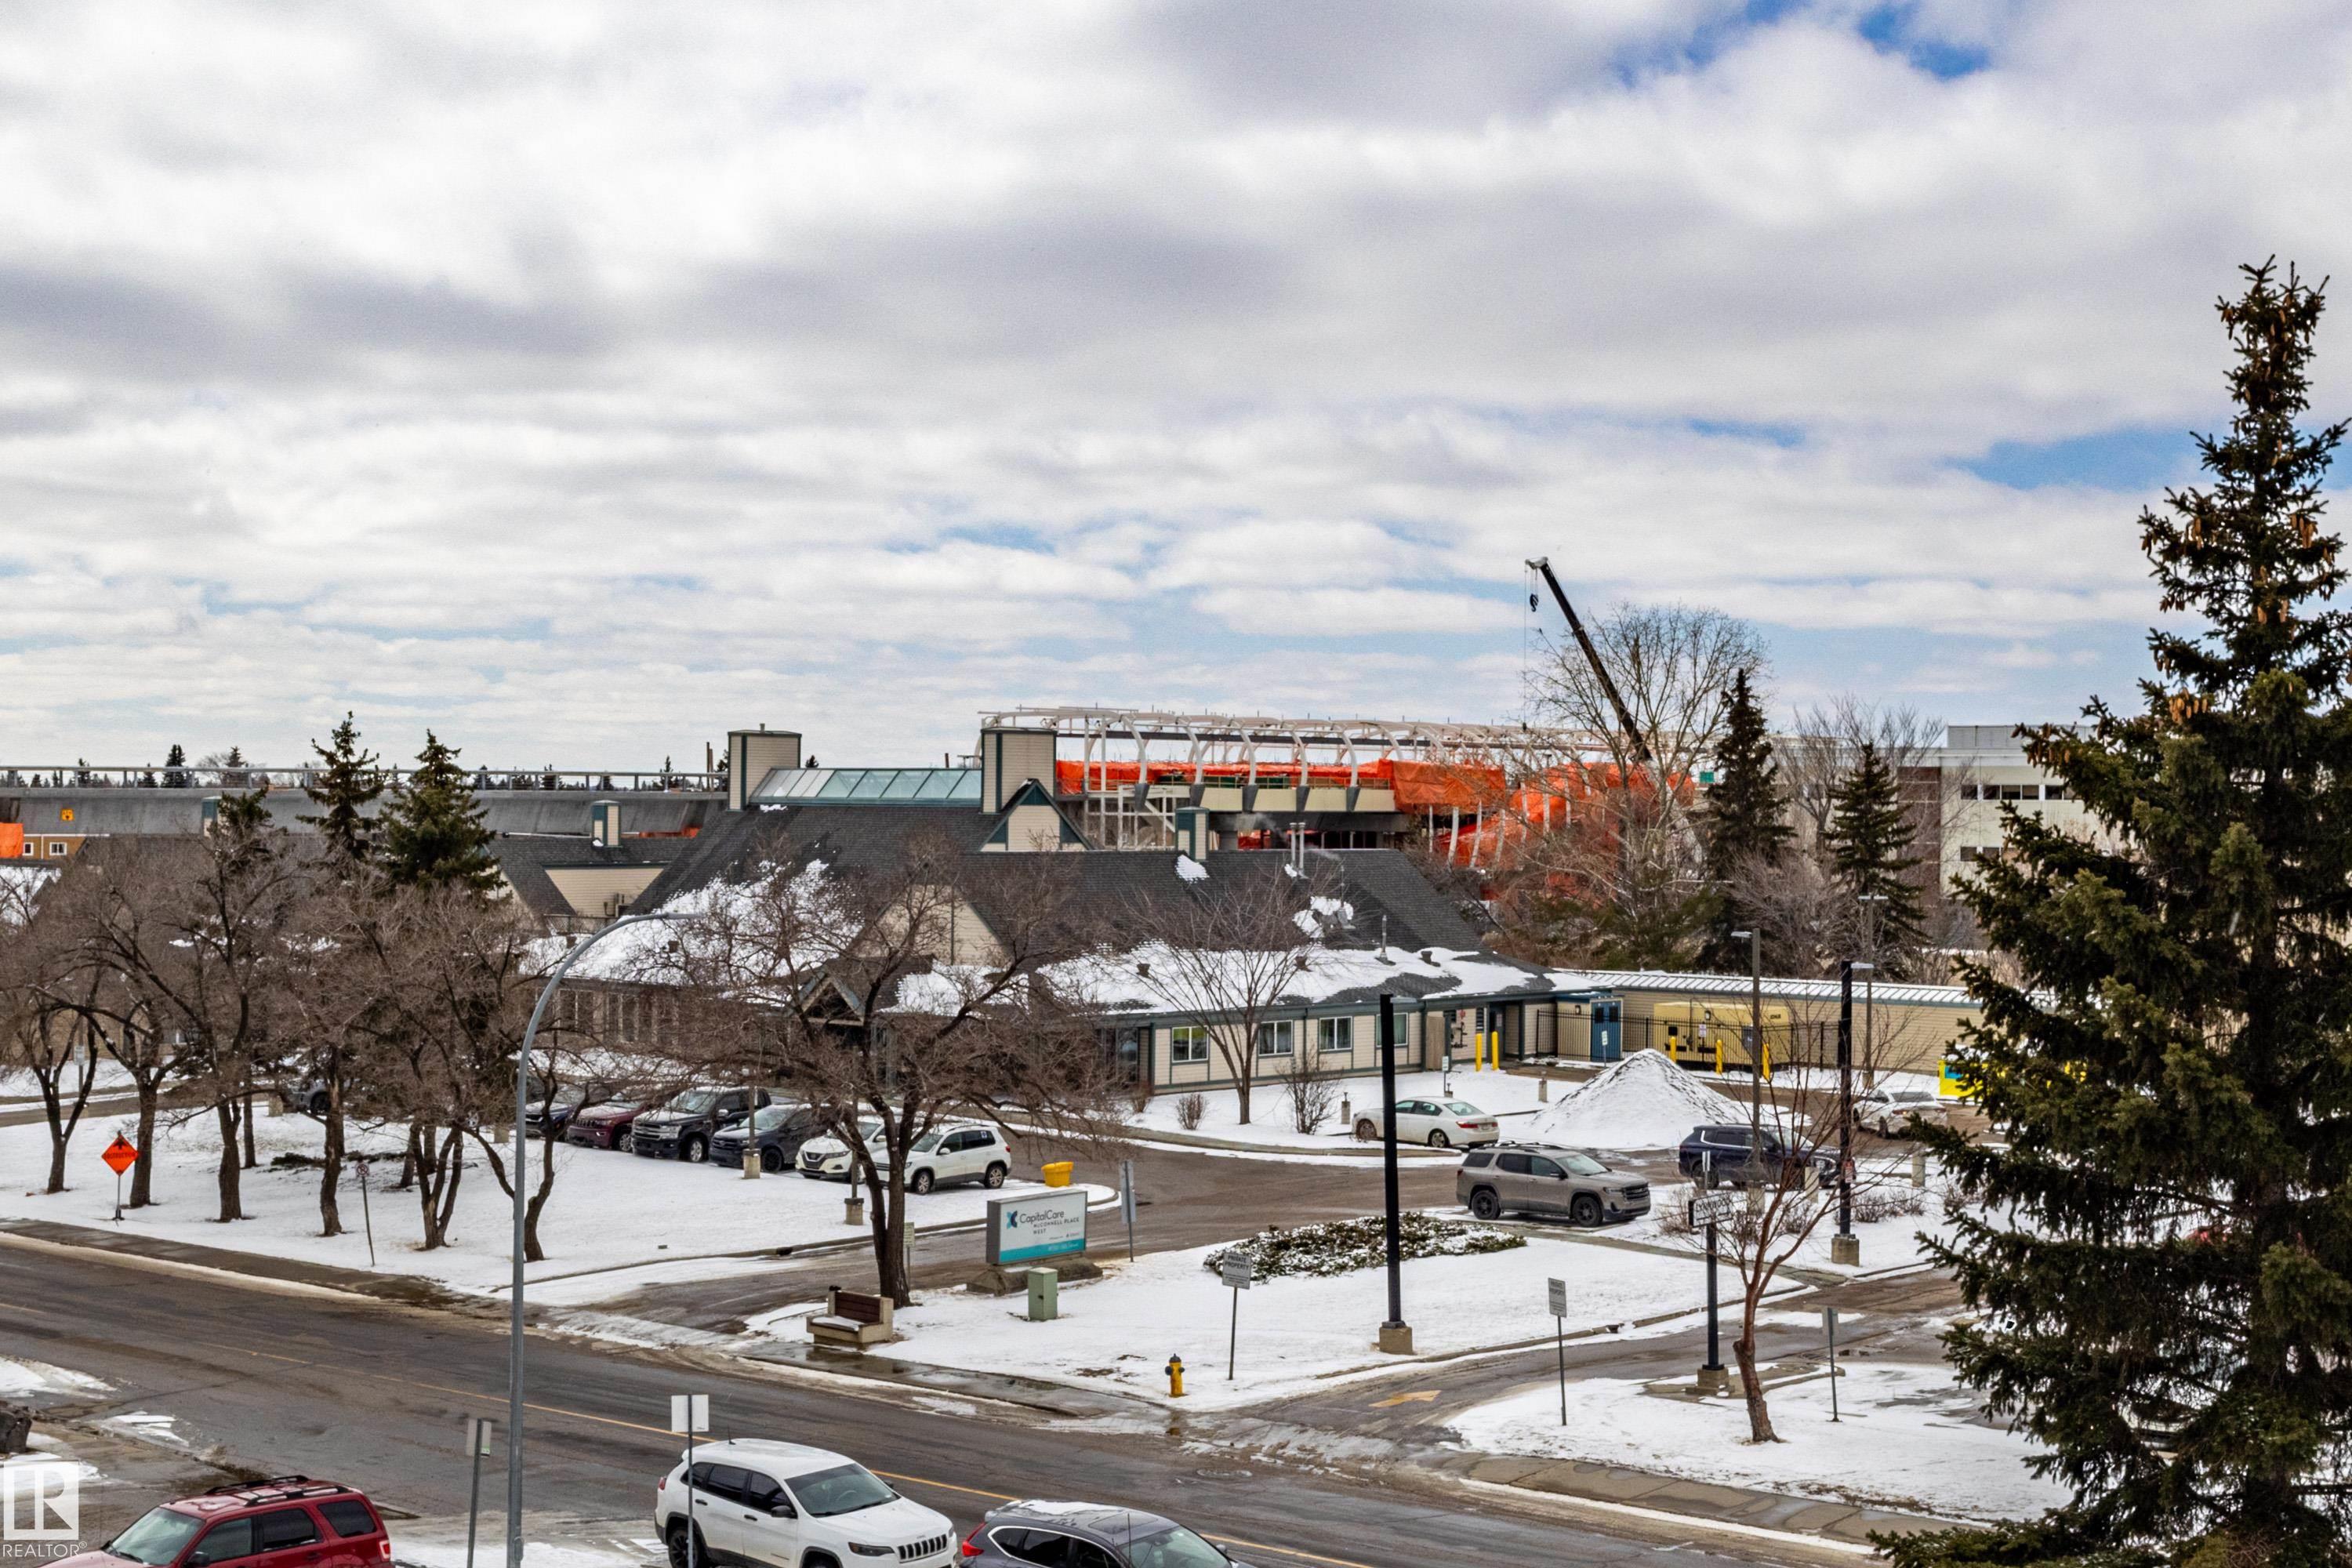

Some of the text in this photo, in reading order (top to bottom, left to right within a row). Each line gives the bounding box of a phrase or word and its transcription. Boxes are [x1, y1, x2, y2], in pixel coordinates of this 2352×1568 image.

[1019, 1210, 1064, 1224] CapitalCare
[1228, 1254, 1247, 1263] PRIVATE
[1225, 1261, 1249, 1270] PROPERTY
